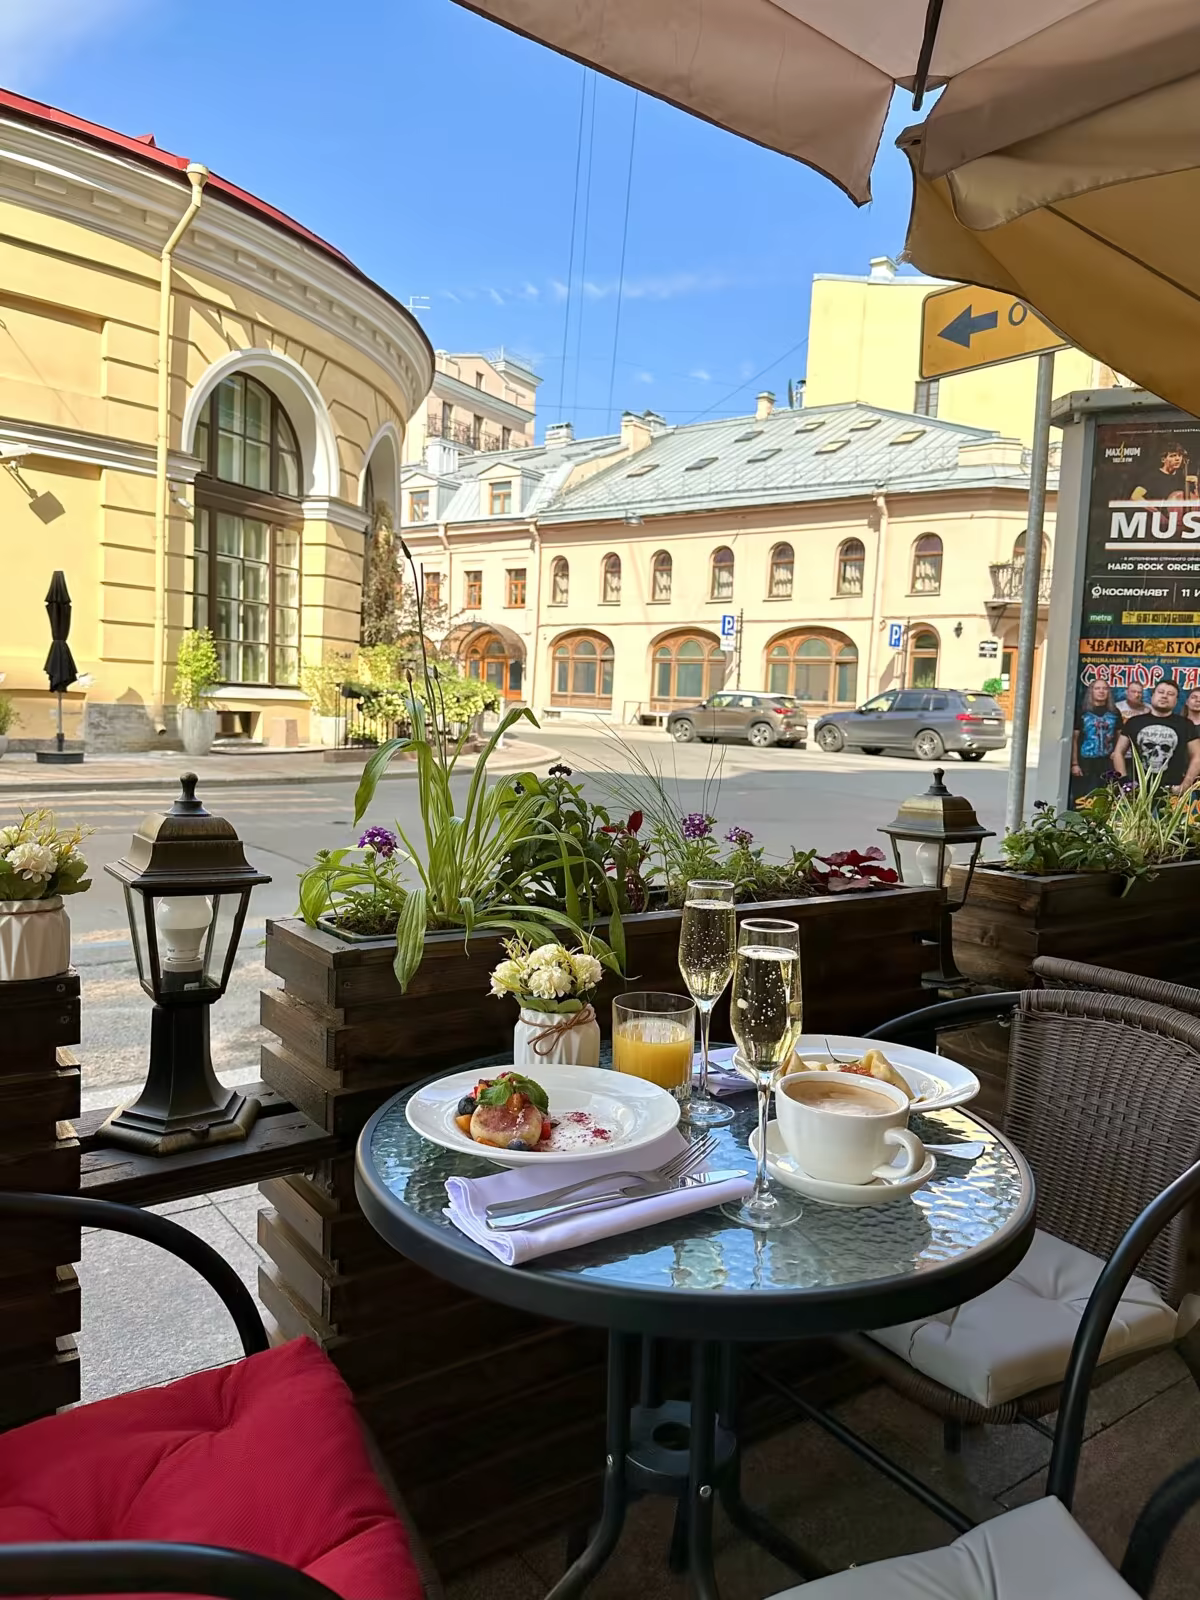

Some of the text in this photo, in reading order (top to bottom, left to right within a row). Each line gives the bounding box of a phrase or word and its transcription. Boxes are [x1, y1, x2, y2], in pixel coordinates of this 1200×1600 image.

[1102, 588, 1169, 597] КОСМОНАВТ
[1181, 589, 1190, 597] 11
[1090, 613, 1112, 622] metro
[1086, 640, 1144, 652] ЧЕРНЫЙ
[1080, 663, 1200, 690] СЕКТОР ГА
